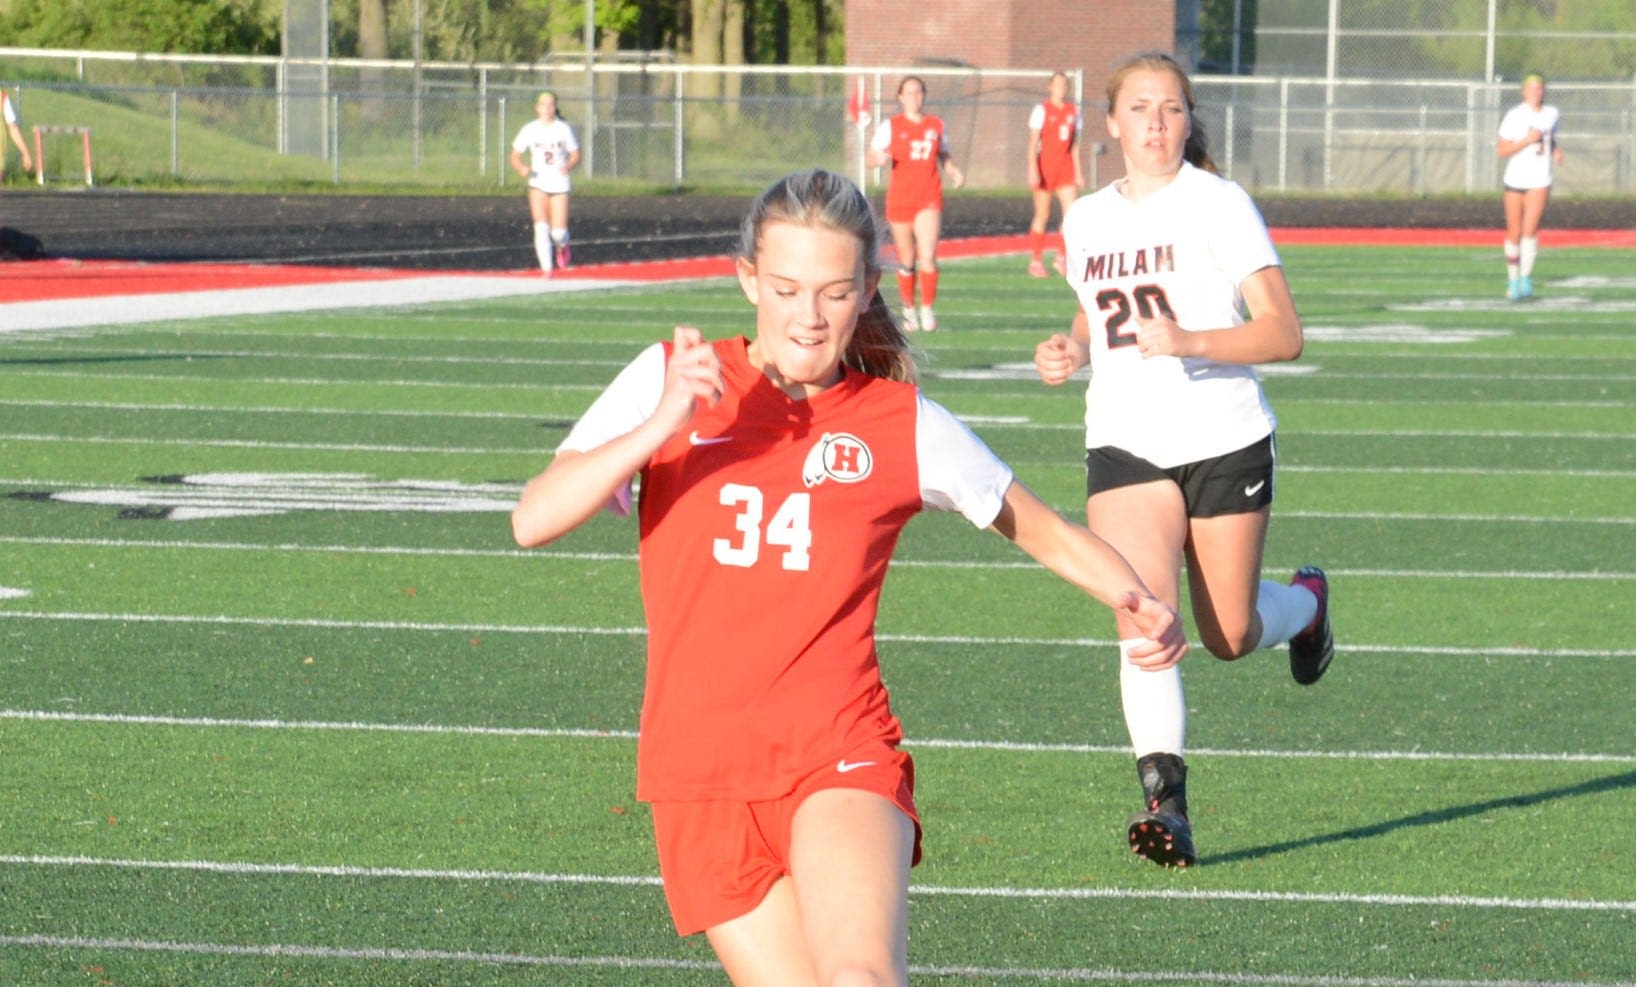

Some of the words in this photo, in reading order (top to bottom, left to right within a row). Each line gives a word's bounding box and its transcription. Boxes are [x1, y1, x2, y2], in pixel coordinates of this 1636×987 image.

[543, 150, 555, 166] 2
[1083, 244, 1175, 283] MILAN
[1095, 283, 1177, 350] 20
[831, 443, 861, 473] H
[713, 483, 812, 571] 34
